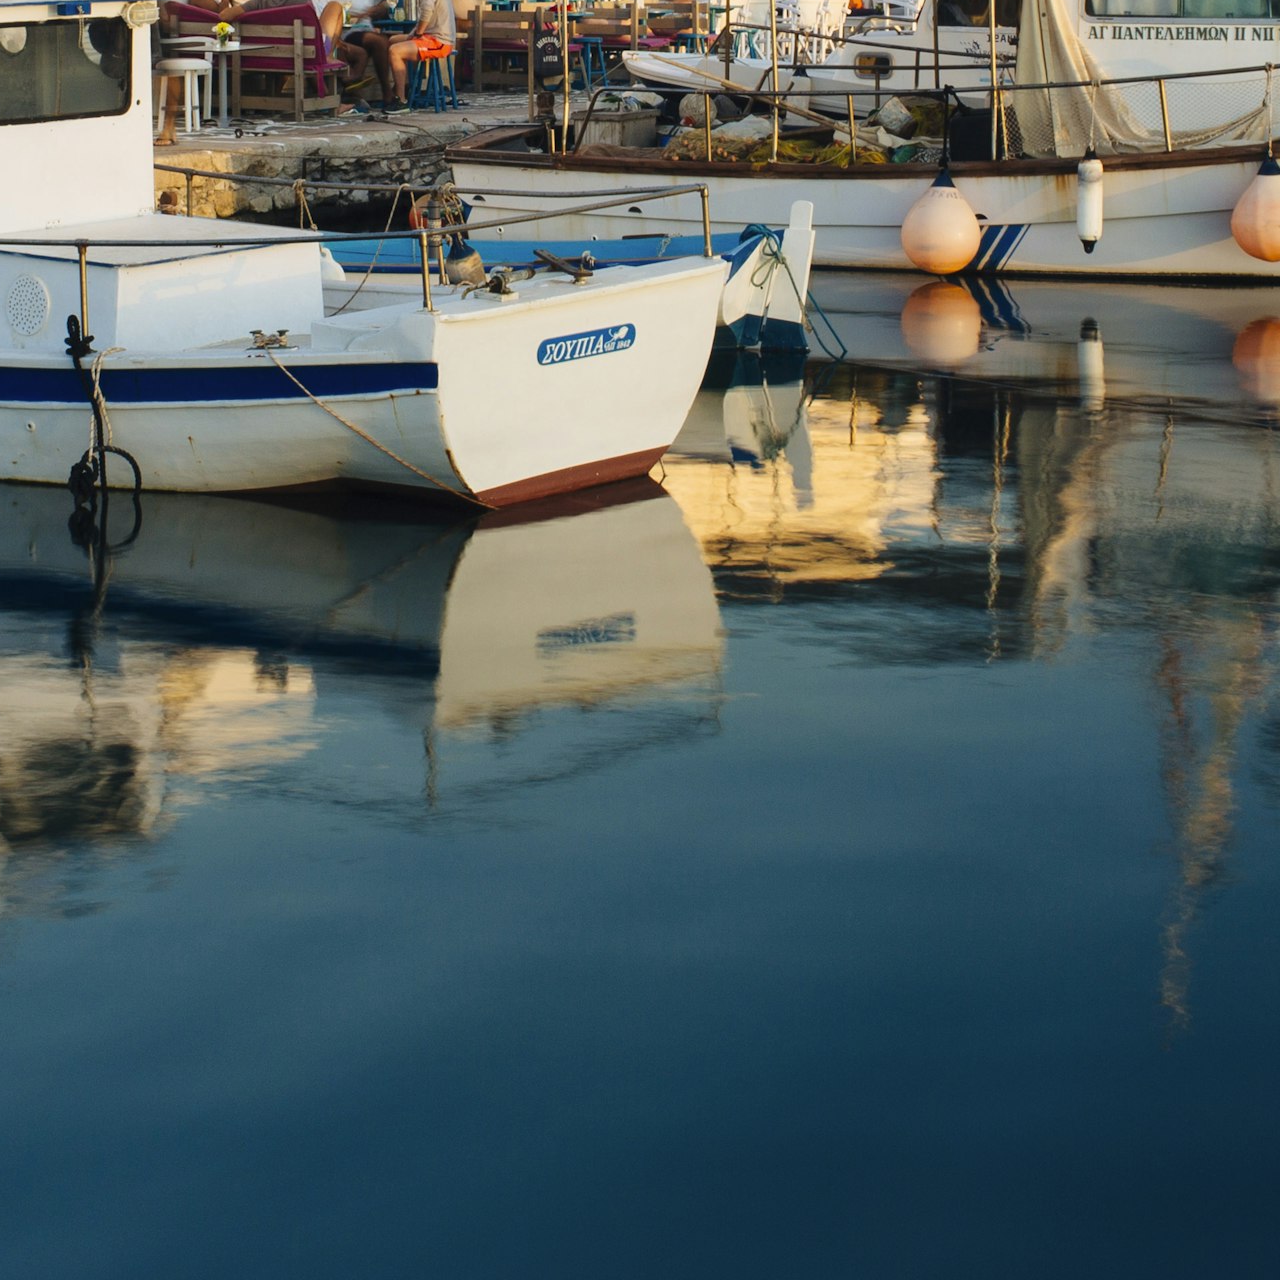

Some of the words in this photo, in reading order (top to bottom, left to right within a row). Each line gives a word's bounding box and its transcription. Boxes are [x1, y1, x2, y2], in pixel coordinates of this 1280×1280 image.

[1088, 26, 1108, 40] ΑΓ
[1112, 26, 1228, 41] ΠΑΝΤΕΛΕΗΜΩΝ
[542, 334, 604, 364] ΣΟΥΠΙΑ
